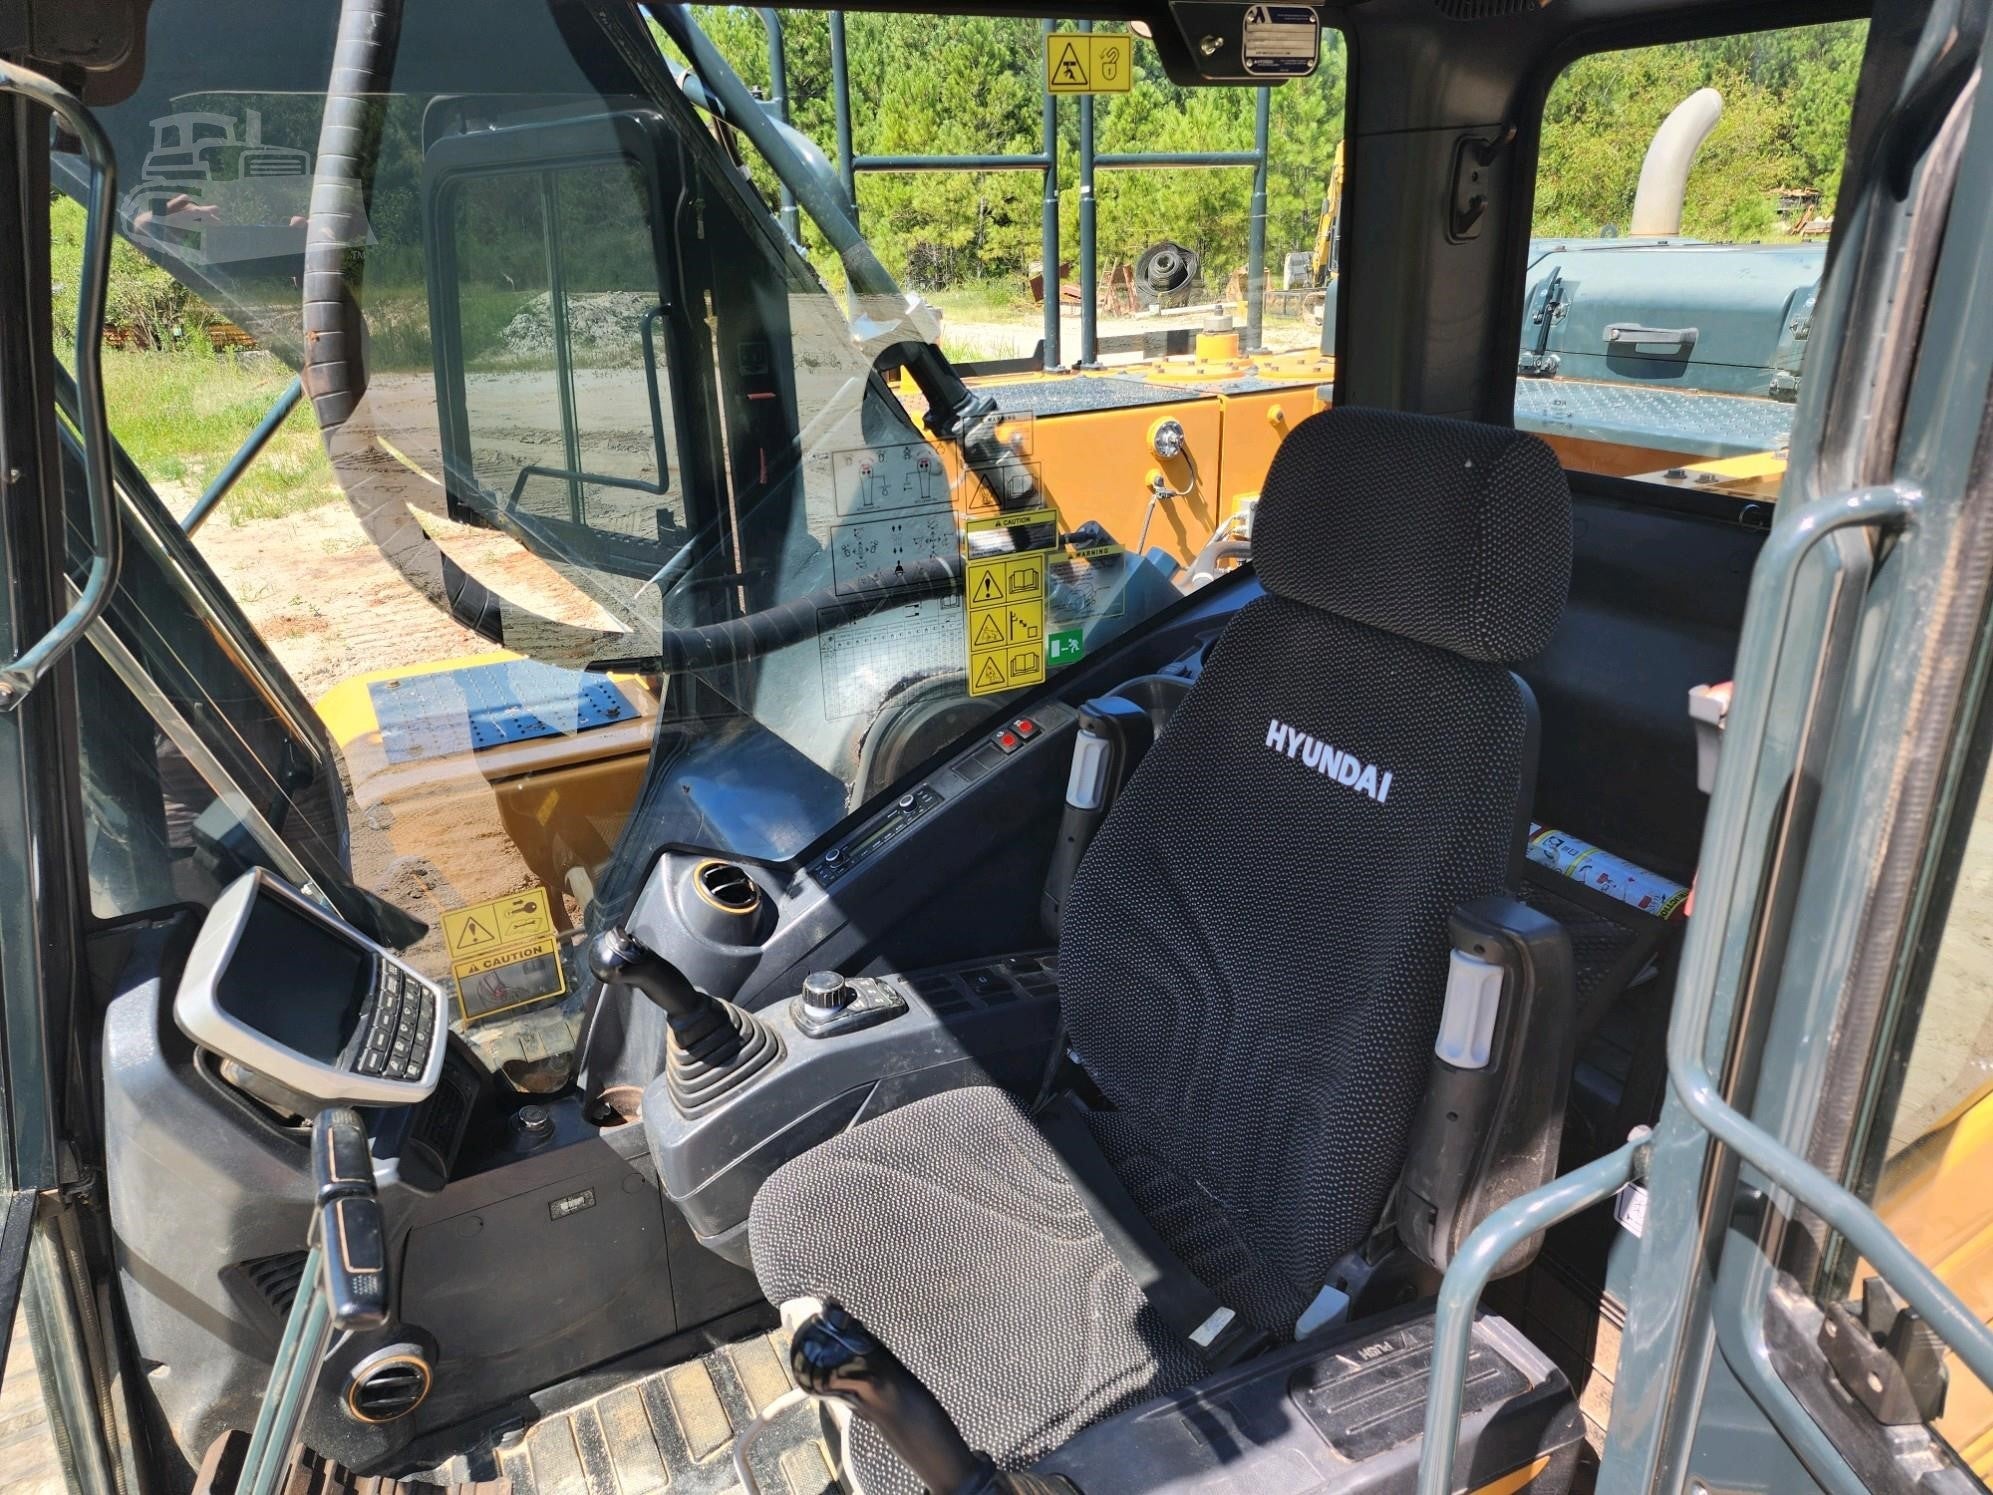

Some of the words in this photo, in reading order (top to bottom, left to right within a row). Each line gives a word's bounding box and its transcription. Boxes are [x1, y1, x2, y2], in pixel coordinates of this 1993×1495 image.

[1003, 517, 1031, 526] CAUTION
[1265, 719, 1393, 803] HYUNDAI
[483, 945, 543, 968] CAUTION
[1357, 1340, 1395, 1361] PUSH
